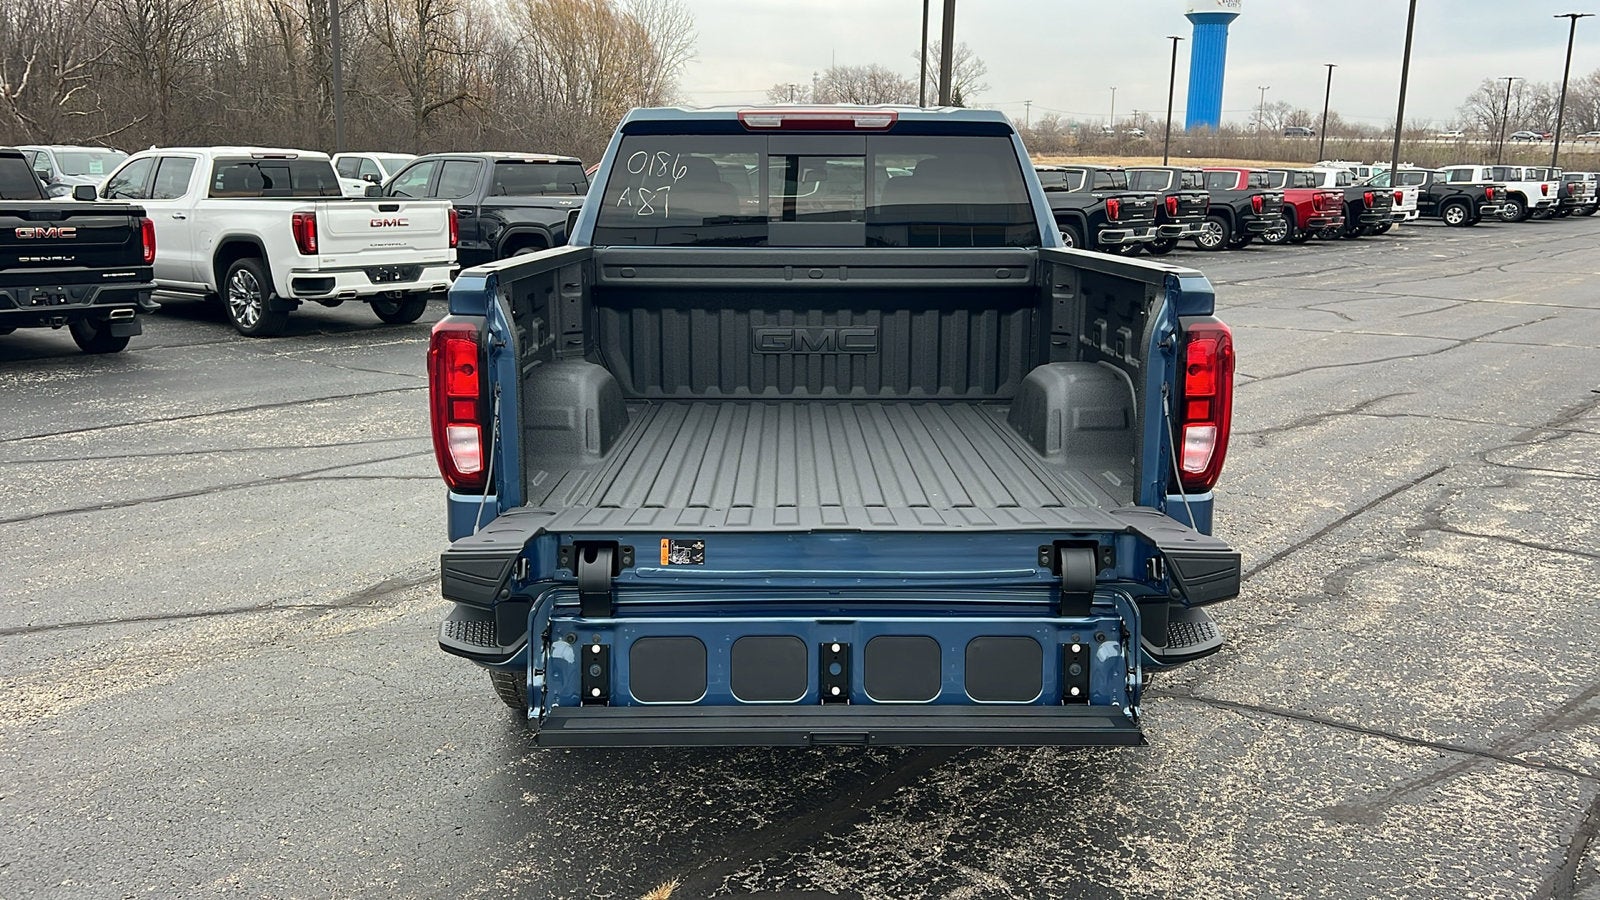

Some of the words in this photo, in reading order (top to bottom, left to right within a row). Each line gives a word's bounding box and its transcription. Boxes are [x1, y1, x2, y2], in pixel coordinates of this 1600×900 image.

[627, 151, 688, 184] 0186
[616, 186, 671, 219] A87
[15, 227, 77, 239] GMC
[369, 217, 409, 228] GMC
[754, 327, 878, 353] GMC
